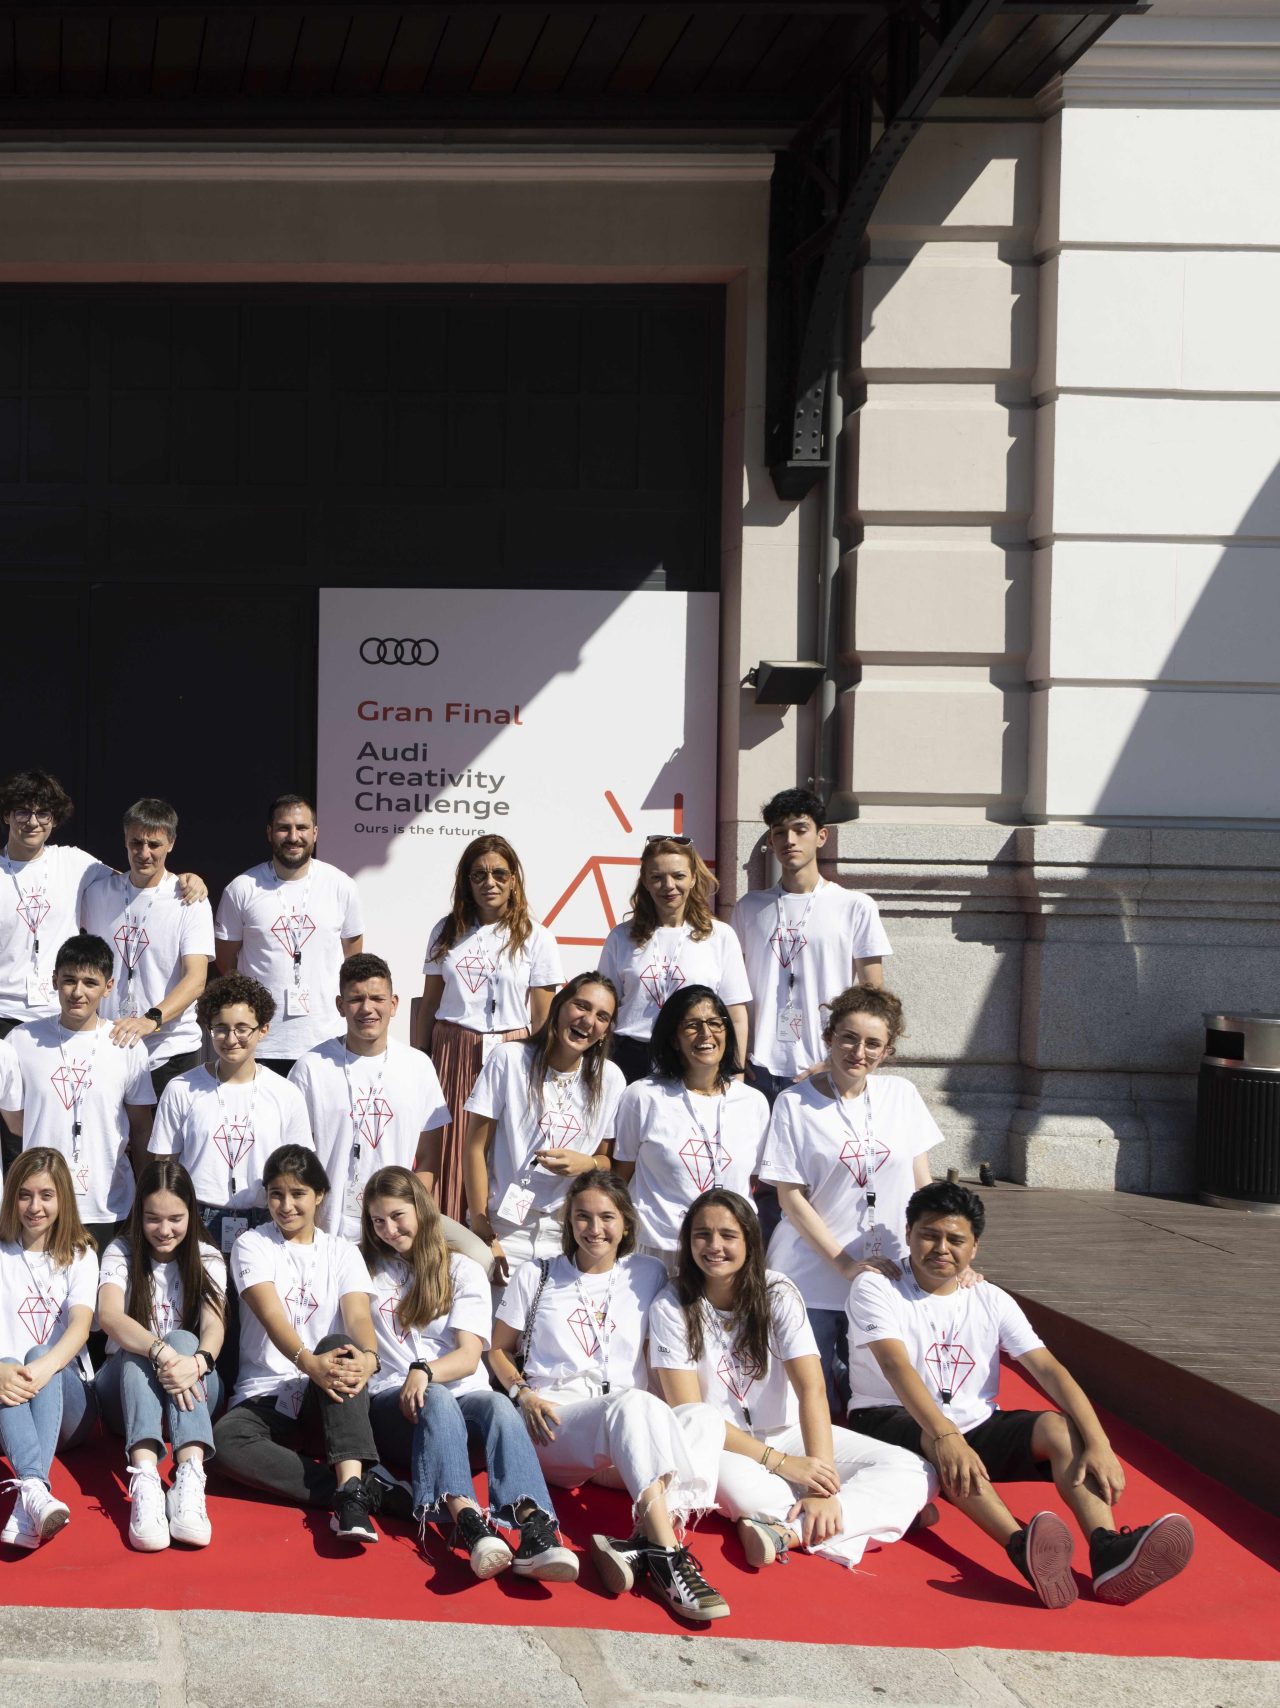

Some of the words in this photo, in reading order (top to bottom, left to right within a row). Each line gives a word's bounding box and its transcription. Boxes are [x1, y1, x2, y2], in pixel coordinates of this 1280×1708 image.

[357, 700, 433, 723] Gran
[445, 703, 524, 726] Final
[356, 741, 428, 762] Audi
[355, 766, 506, 794] Creativity
[354, 791, 510, 820] Challenge
[354, 822, 389, 834] Ours
[393, 824, 405, 834] is
[409, 825, 434, 835] the
[439, 825, 486, 837] future
